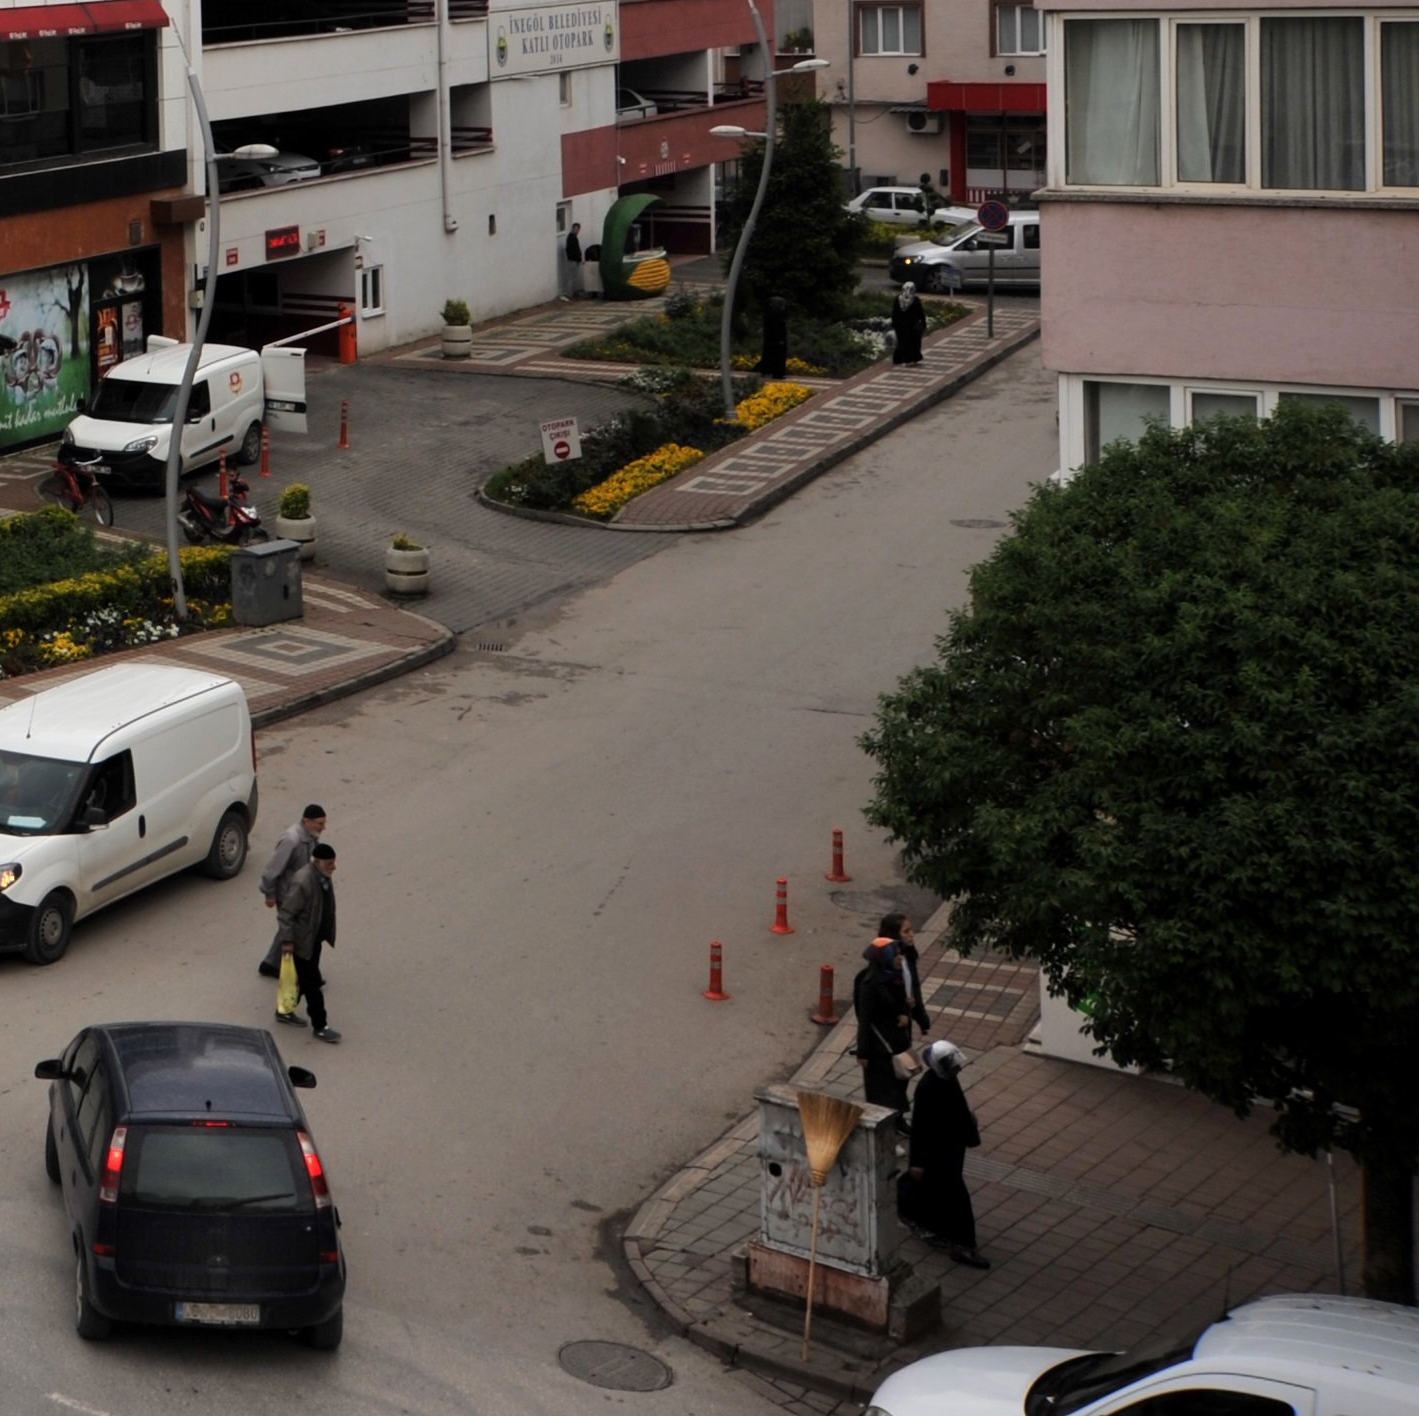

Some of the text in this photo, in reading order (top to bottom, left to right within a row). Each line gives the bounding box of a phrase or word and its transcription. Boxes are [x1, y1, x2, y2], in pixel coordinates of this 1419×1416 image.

[509, 6, 602, 34] İNEGÖL BELEDİYESİ
[522, 30, 594, 55] KATLI OTOPARK
[542, 420, 575, 432] OTOPARK
